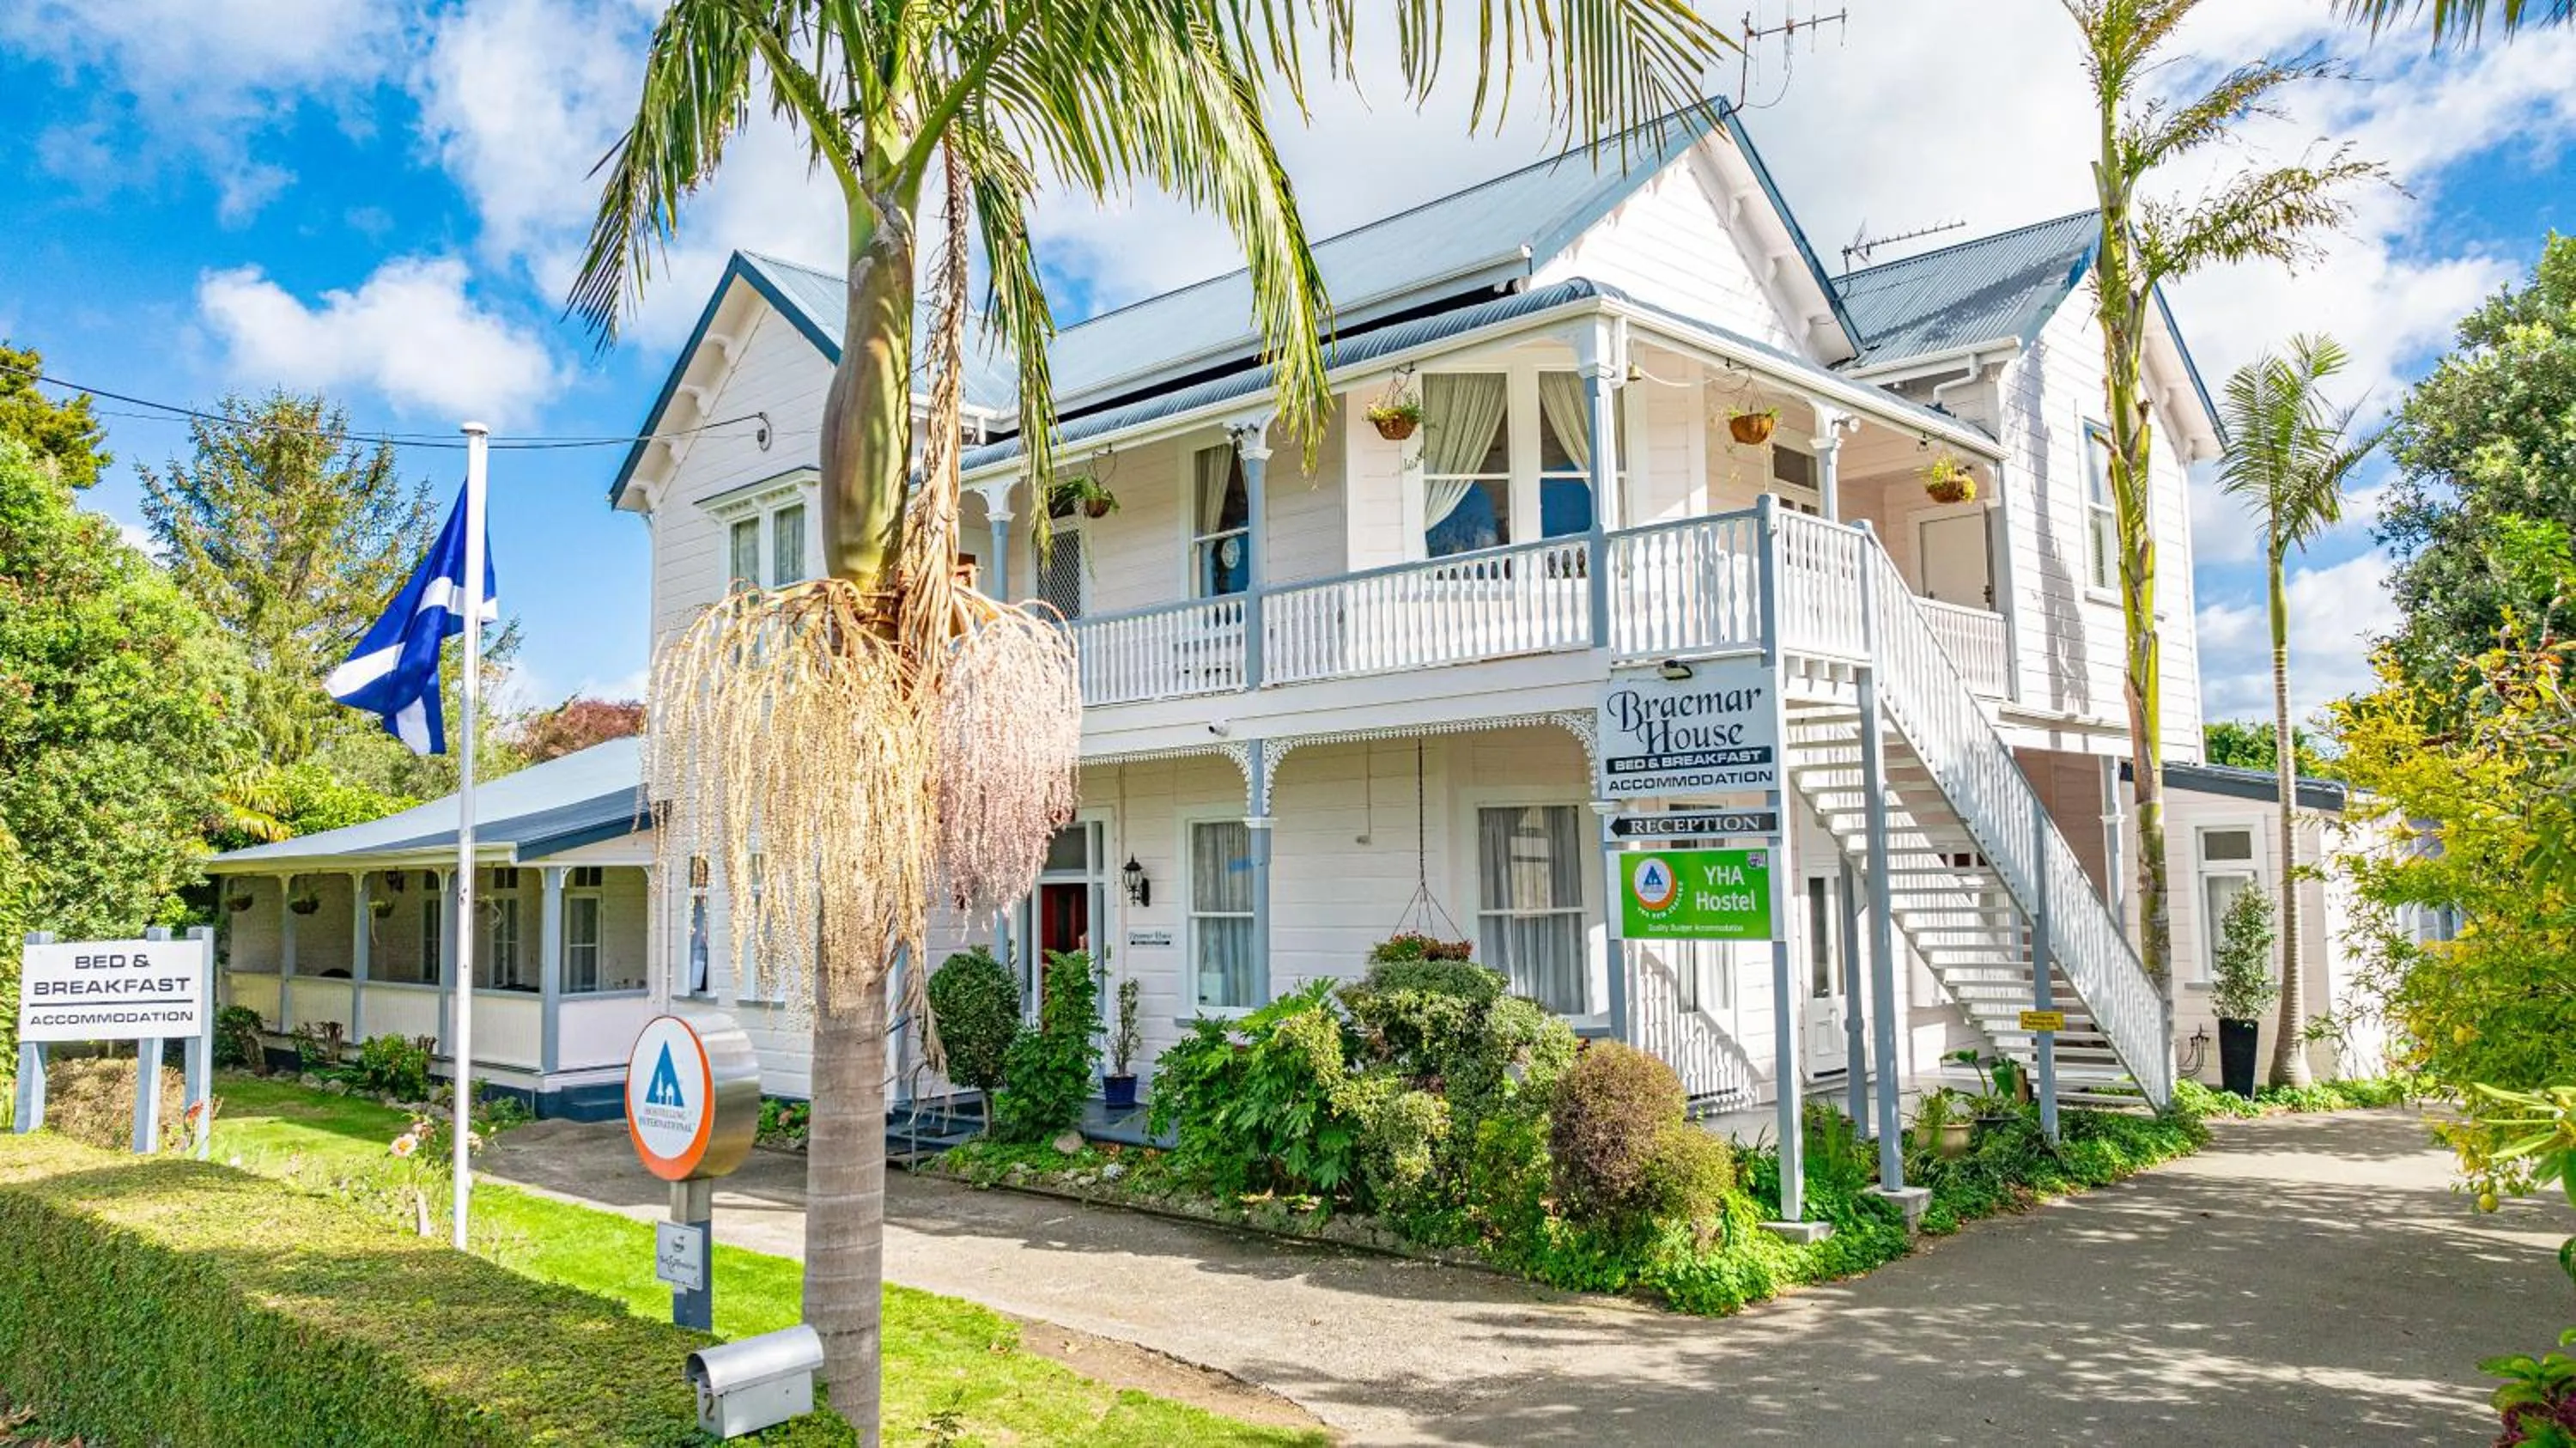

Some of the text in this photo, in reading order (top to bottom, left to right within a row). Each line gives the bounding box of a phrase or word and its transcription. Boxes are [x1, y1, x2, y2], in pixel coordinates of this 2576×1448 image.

[1607, 687, 1762, 733] Braemar
[1636, 719, 1745, 754] House
[1614, 751, 1762, 771] BED & BREAKFAST
[1608, 771, 1773, 791] ACCOMMODATION
[1630, 817, 1760, 834] RECEPTION
[1704, 865, 1745, 886] YHA
[1695, 890, 1757, 912] Hostel
[75, 954, 150, 970] BED &
[33, 977, 191, 995] BREAKFAST
[30, 1011, 193, 1025] ACCOMMODATION
[703, 1392, 715, 1421] 2
